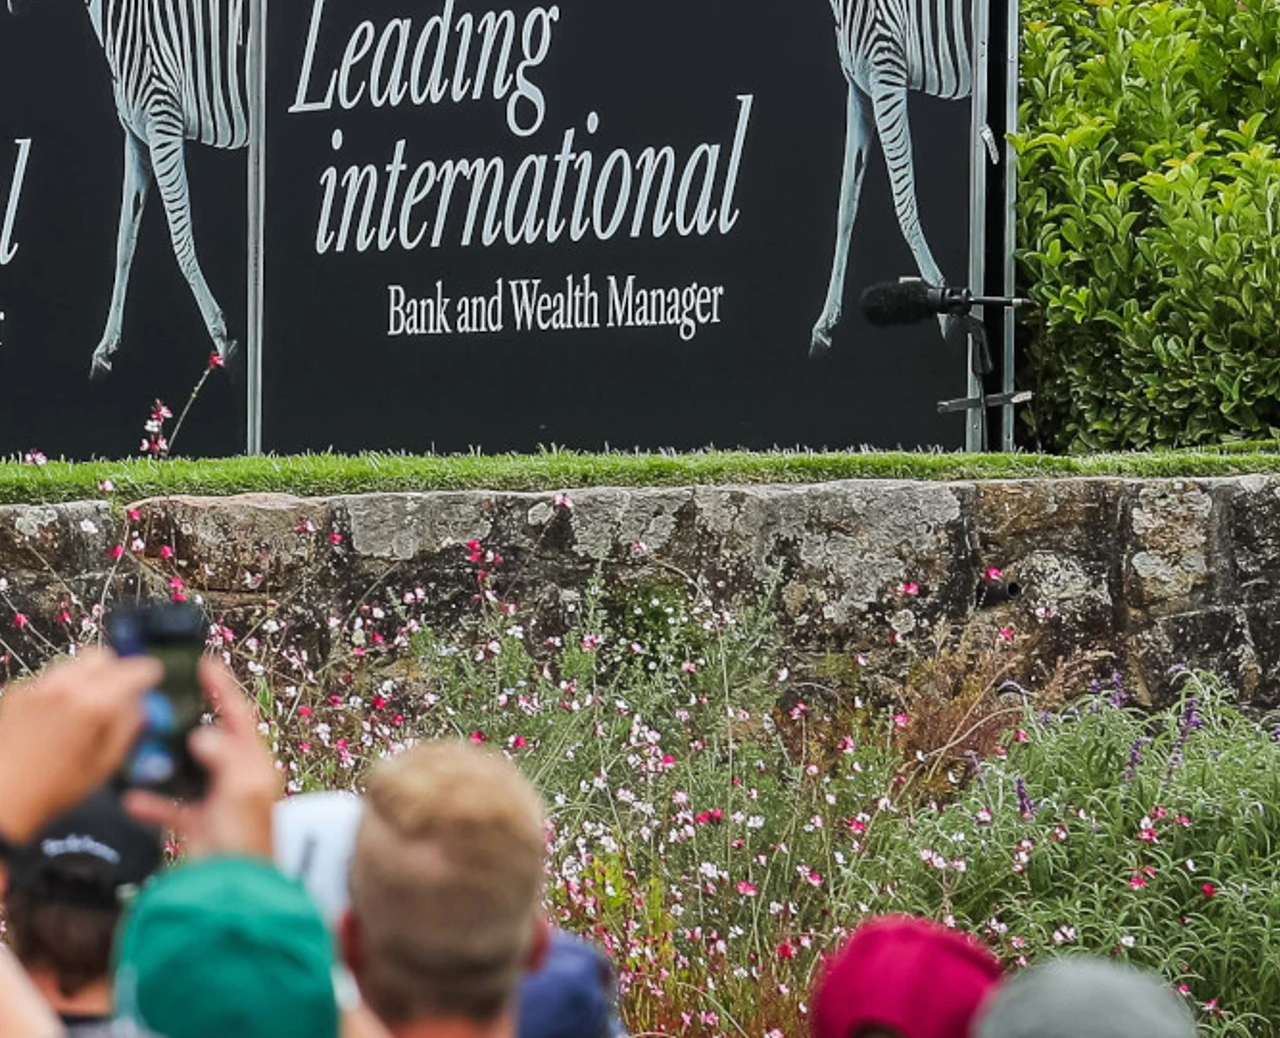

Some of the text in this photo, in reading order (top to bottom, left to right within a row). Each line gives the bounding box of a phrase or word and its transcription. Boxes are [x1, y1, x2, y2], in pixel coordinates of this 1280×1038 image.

[315, 94, 754, 255] international
[387, 273, 724, 340] Bank and Wealth Manager
